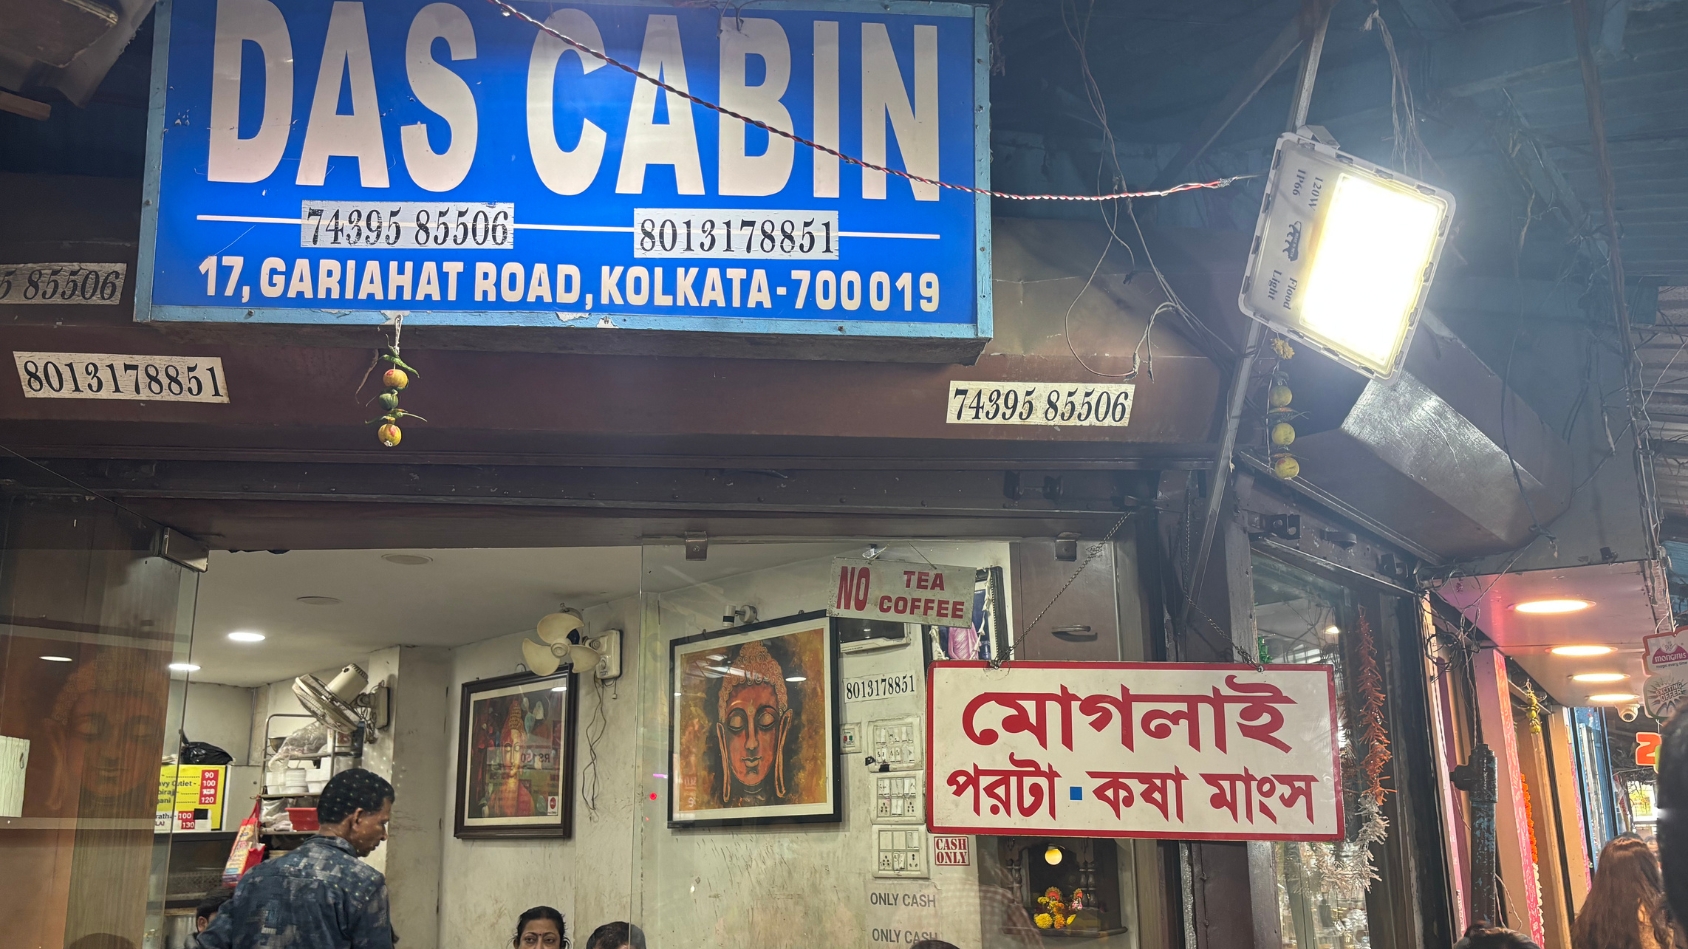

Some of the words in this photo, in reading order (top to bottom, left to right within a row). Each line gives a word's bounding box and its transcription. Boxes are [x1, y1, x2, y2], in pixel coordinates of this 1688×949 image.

[208, 0, 478, 193] DAS
[526, 8, 940, 201] CABIN
[1292, 168, 1307, 196] IP66
[306, 206, 402, 246] 74395
[414, 207, 509, 246] 85506
[640, 217, 835, 254] 8013178851
[24, 267, 121, 300] 85506
[260, 257, 464, 301] GARIAHAT
[1267, 269, 1282, 300] Light
[1282, 277, 1298, 310] Flood
[24, 360, 223, 397] 8013178851
[953, 387, 1036, 421] 74395
[1044, 387, 1129, 422] 85506
[836, 566, 871, 611] NO
[904, 570, 945, 591] TEA
[879, 595, 965, 619] COFFEE
[846, 675, 915, 700] 8013178851
[1660, 689, 1682, 702] OFFER
[962, 675, 1298, 754] মোগলাই
[947, 752, 1062, 821] পরটা
[1085, 765, 1189, 823] কষা
[1199, 766, 1319, 824] মাংস
[936, 839, 967, 851] CASH
[937, 852, 967, 864] ONLY
[870, 892, 899, 906] ONLY
[902, 894, 936, 908] CASH
[872, 928, 901, 943] ONLY
